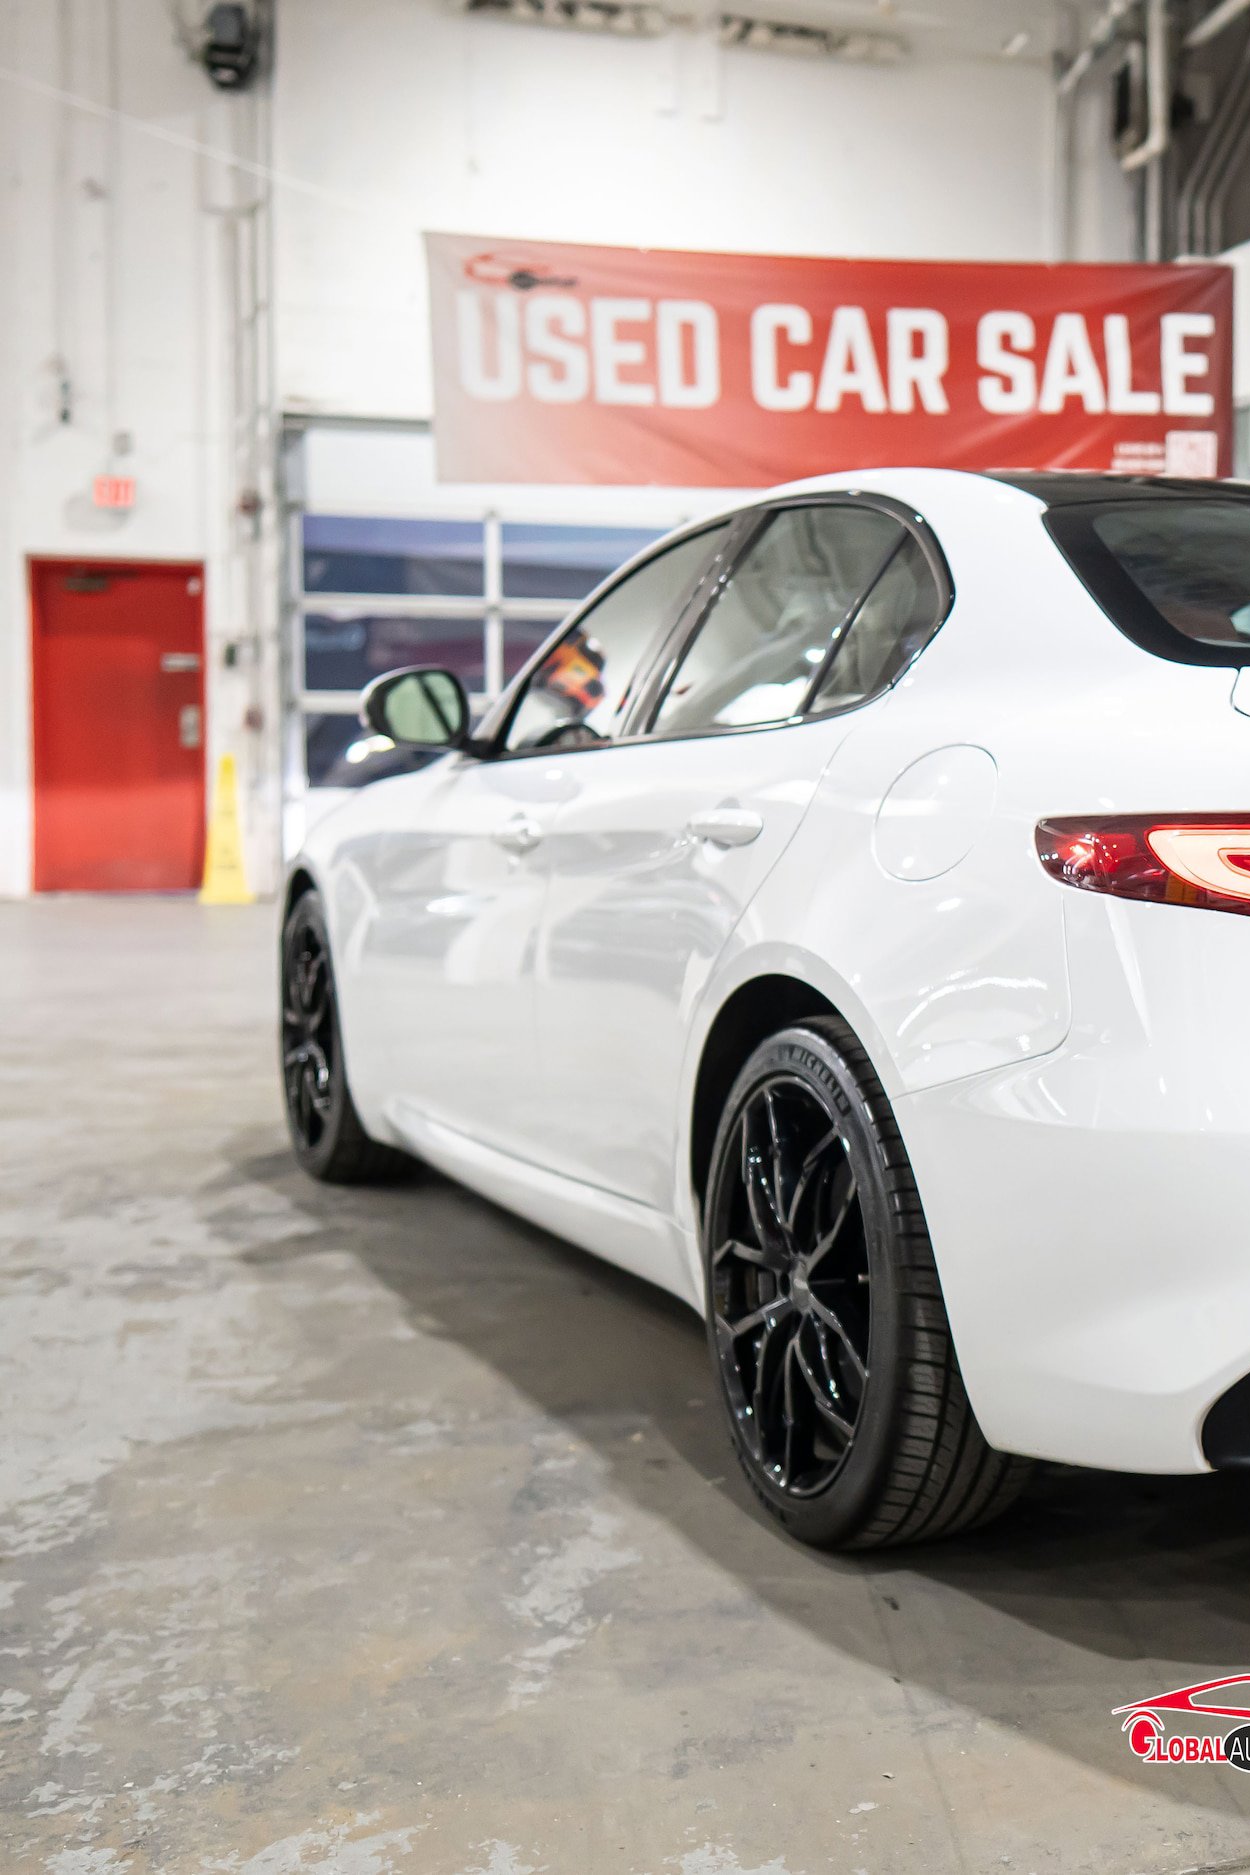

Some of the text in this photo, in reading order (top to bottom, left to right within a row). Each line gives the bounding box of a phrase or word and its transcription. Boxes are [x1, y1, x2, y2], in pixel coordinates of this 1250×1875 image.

[456, 290, 1215, 417] USED CAR SALE
